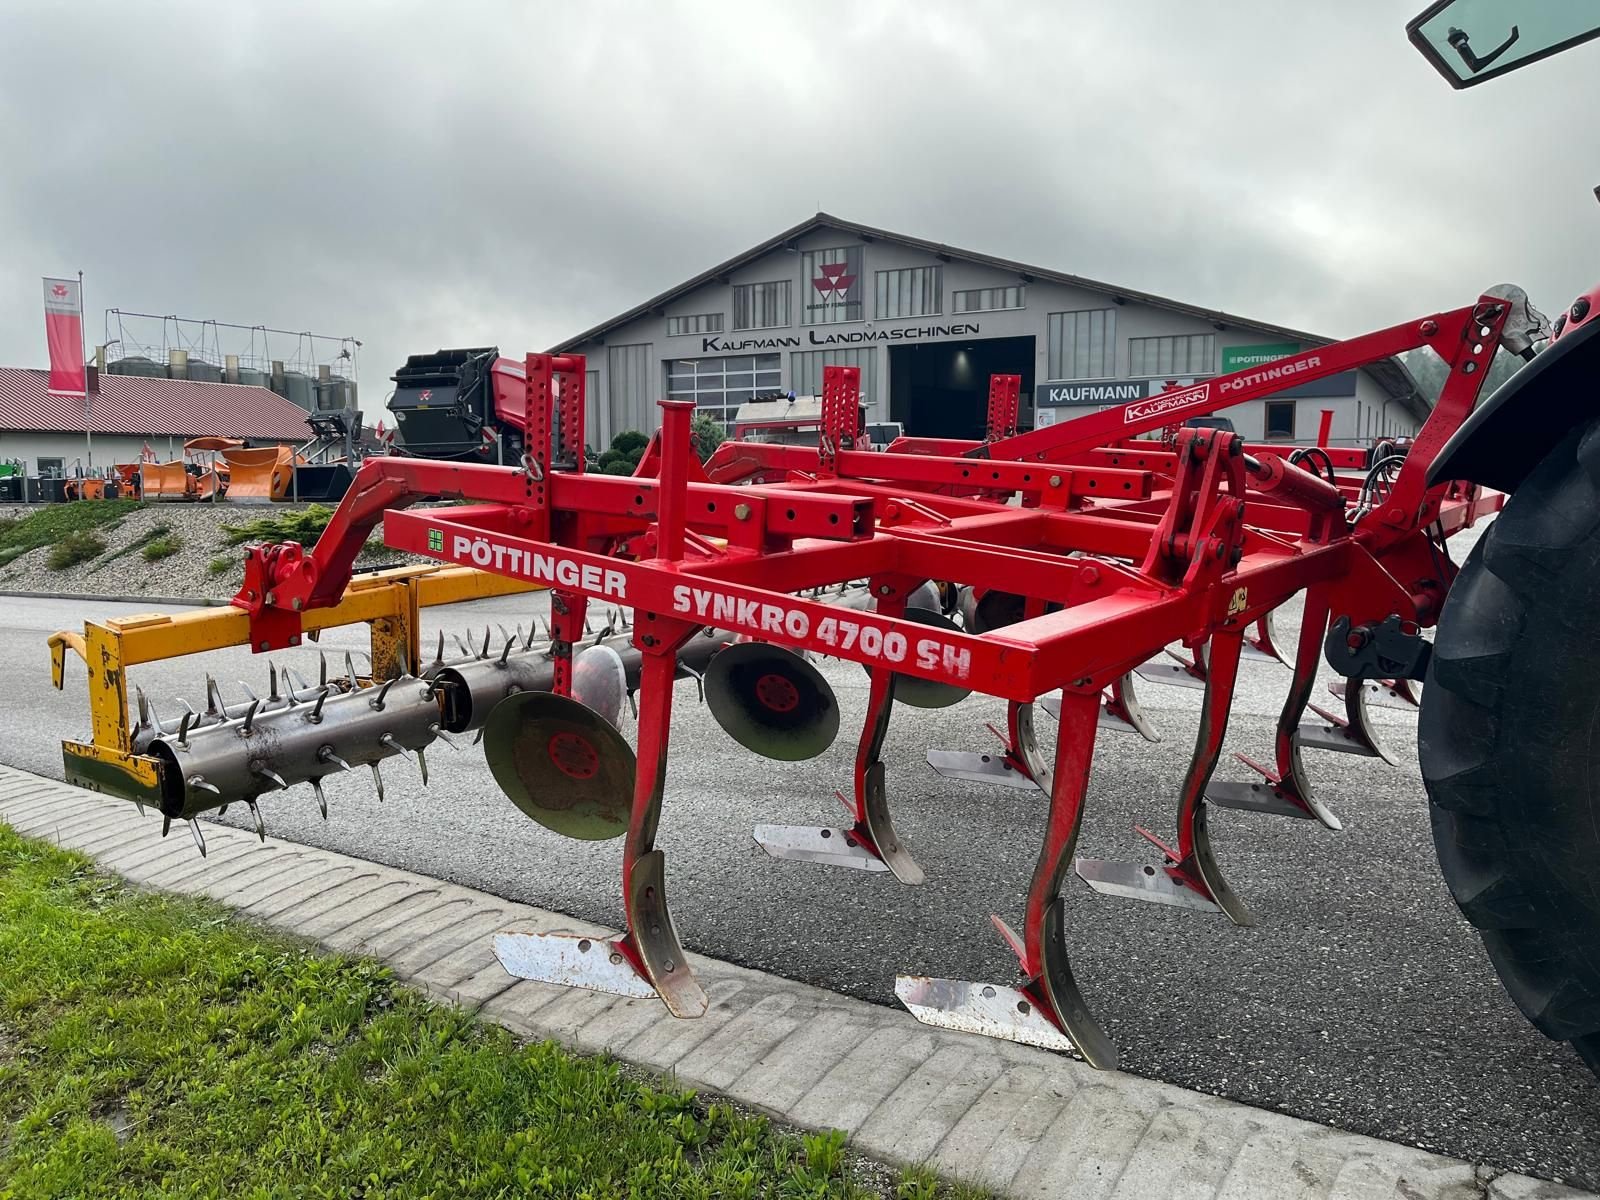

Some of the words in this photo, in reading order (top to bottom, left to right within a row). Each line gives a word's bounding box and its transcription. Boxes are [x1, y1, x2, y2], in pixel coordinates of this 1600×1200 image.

[702, 337, 800, 352] KAUFMANN
[808, 323, 980, 345] LANDMASCHINEN
[1219, 357, 1321, 393] PÖTTINGER
[1050, 385, 1140, 402] KAUFMANN
[1127, 392, 1205, 419] KAUFMANN
[453, 535, 627, 599] PÖTTINGER
[673, 584, 809, 639] SYNKRO
[816, 617, 908, 663] 4700
[916, 638, 972, 679] SH
